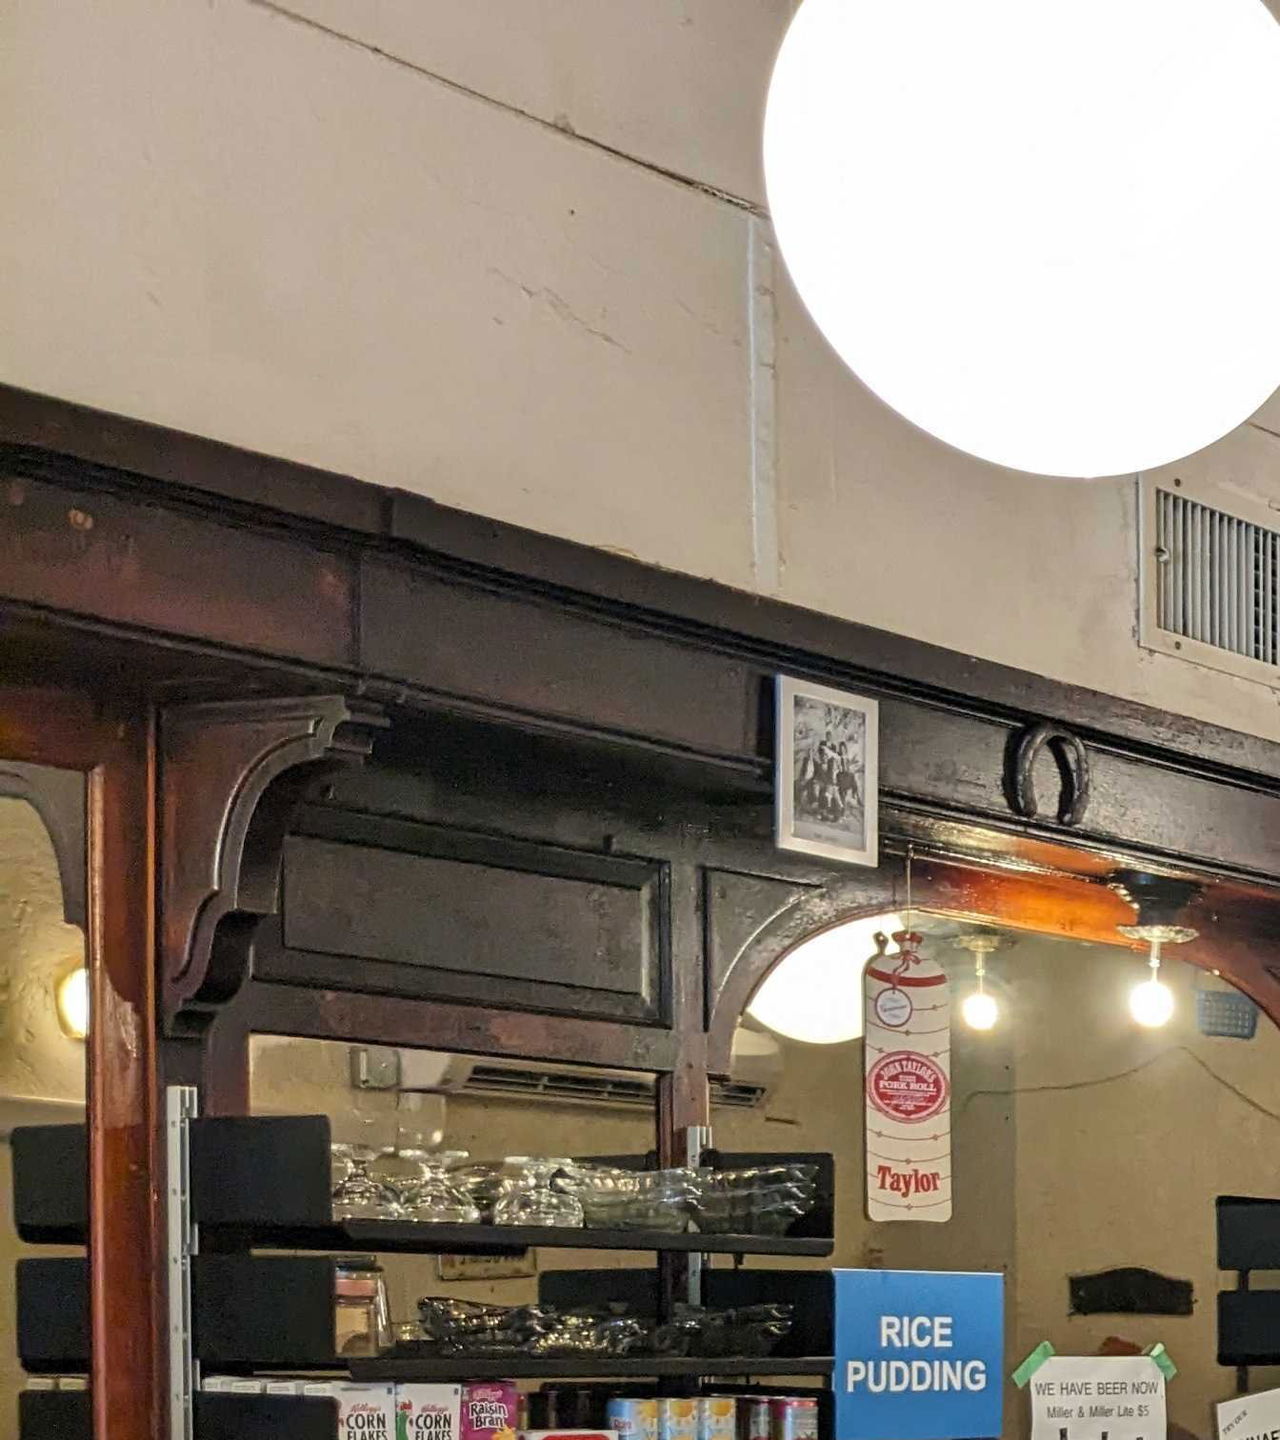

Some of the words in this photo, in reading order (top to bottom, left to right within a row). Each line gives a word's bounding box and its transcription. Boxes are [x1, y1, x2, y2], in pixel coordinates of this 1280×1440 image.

[879, 1079, 908, 1090] PORK
[909, 1080, 937, 1091] ROLL
[877, 1165, 940, 1198] Taylor
[880, 1315, 953, 1347] RICE
[847, 1360, 986, 1392] PUDDING
[1035, 1382, 1055, 1396] WE
[1060, 1382, 1092, 1396] HAVE
[1097, 1382, 1128, 1395] BEER
[1131, 1381, 1159, 1394] NOW
[469, 1401, 508, 1419] Raisin
[1047, 1406, 1073, 1418] Miller
[1077, 1406, 1085, 1418] &
[1089, 1406, 1114, 1418] Miller
[1117, 1406, 1134, 1417] Lite
[1138, 1405, 1150, 1417] $5
[346, 1413, 386, 1430] CORN
[415, 1413, 452, 1430] CORN
[473, 1415, 505, 1429] Bran
